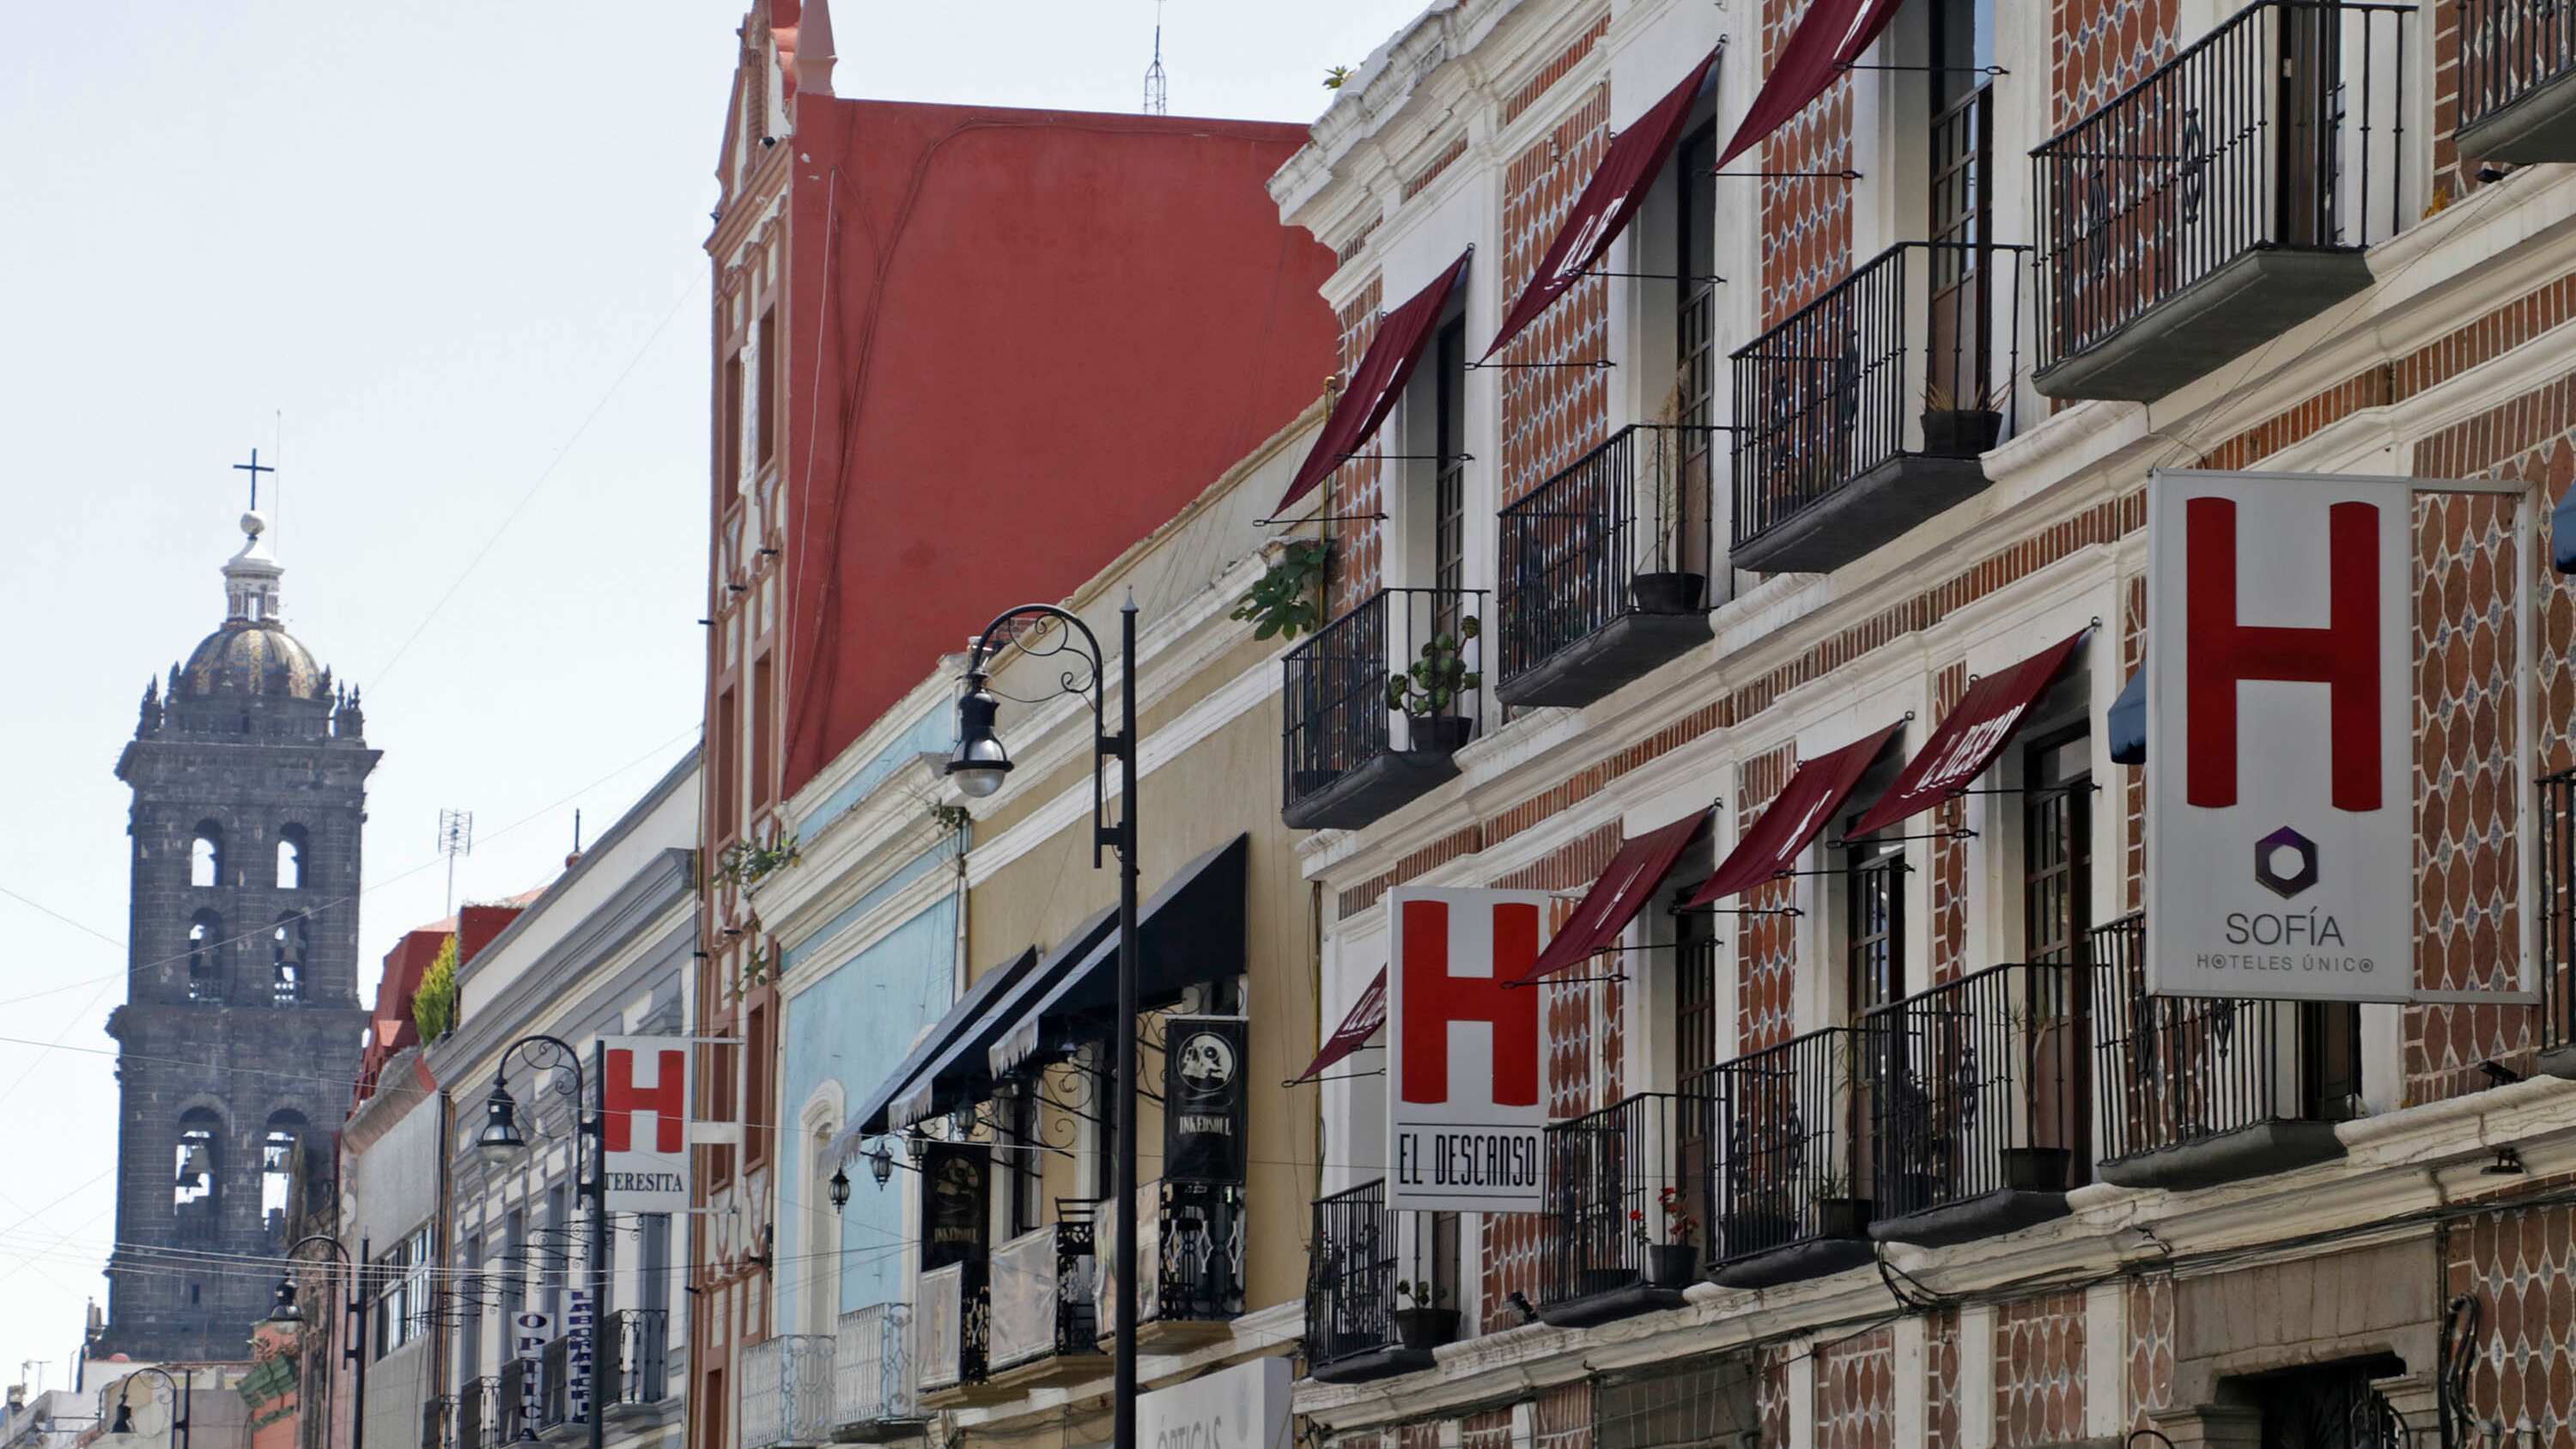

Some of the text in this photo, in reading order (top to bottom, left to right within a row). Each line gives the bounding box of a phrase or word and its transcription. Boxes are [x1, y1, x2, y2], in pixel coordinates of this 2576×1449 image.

[2186, 496, 2383, 813] H
[2226, 905, 2345, 947] SOFÍA
[2196, 953, 2374, 974] HOTELES ÚNICO
[1401, 900, 1539, 1106] H
[605, 1049, 684, 1154] H
[605, 1172, 683, 1192] TERESITA
[1400, 1133, 1536, 1187] EL DESCANSO
